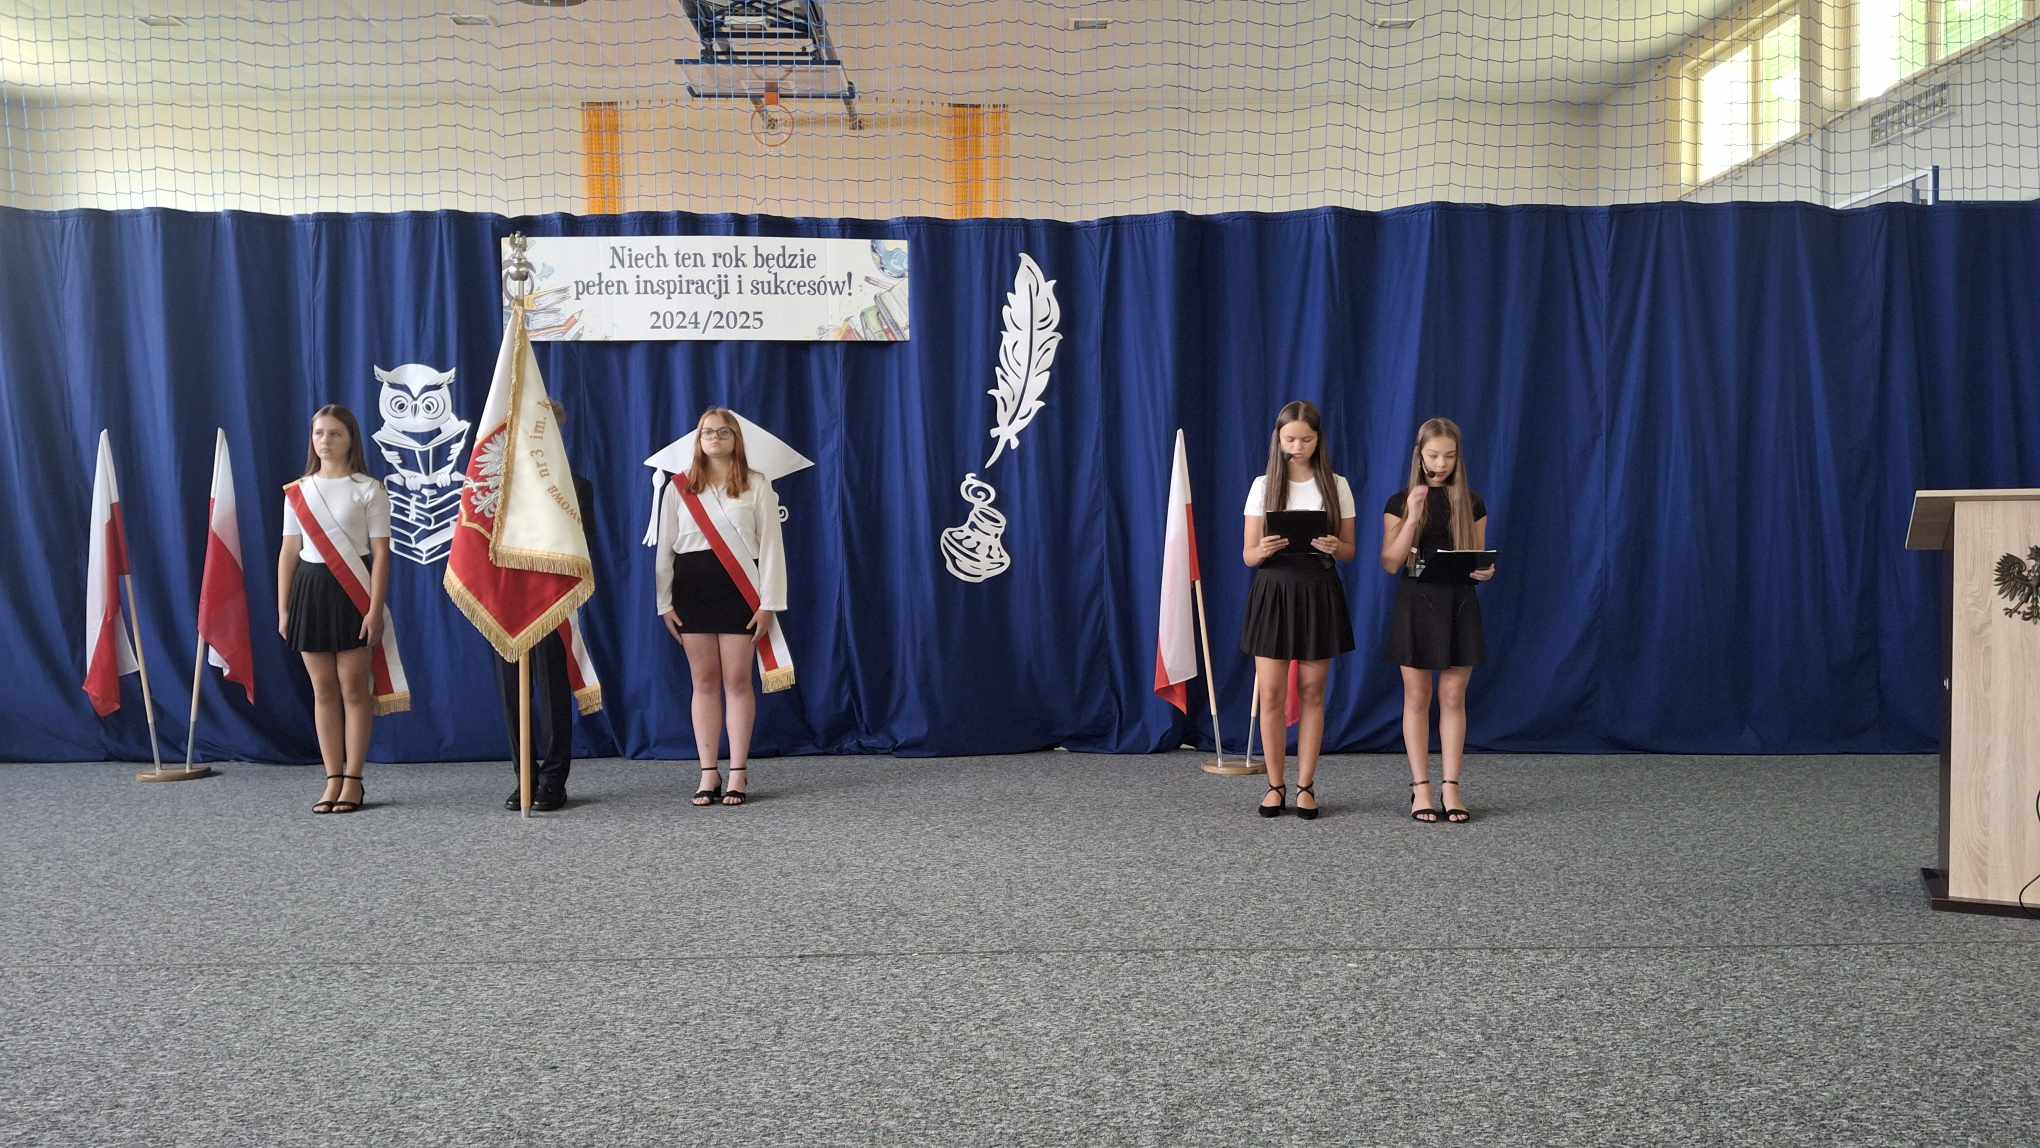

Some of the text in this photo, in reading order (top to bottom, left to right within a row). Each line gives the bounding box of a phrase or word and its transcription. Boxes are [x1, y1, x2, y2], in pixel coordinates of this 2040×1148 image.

[609, 245, 817, 274] Niech ten rok będzie
[574, 271, 853, 301] pełen inspiracji i sukcesów!
[650, 310, 764, 335] 2024/2025
